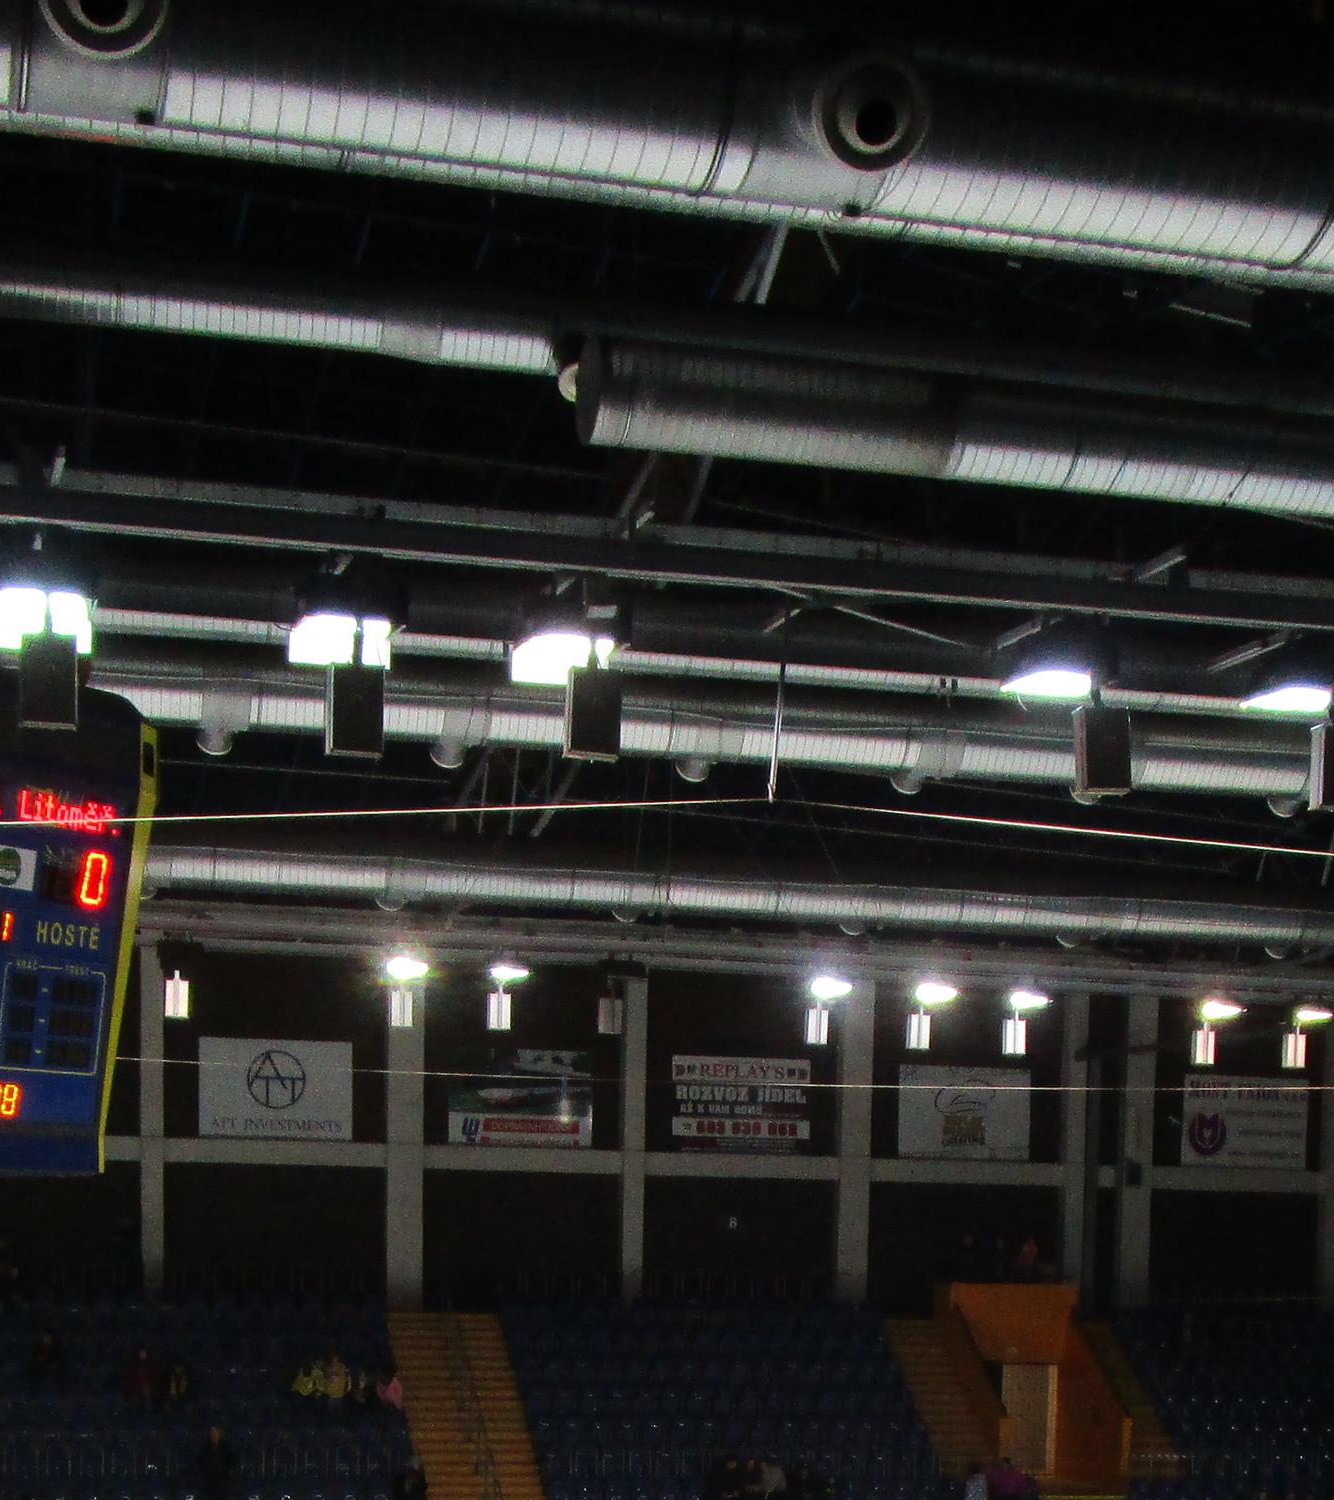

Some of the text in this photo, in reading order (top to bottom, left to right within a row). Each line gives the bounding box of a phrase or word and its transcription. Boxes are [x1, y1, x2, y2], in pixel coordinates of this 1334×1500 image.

[78, 850, 111, 909] 0
[36, 919, 102, 950] HOSTÉ
[675, 1085, 750, 1101] ROZVOZ
